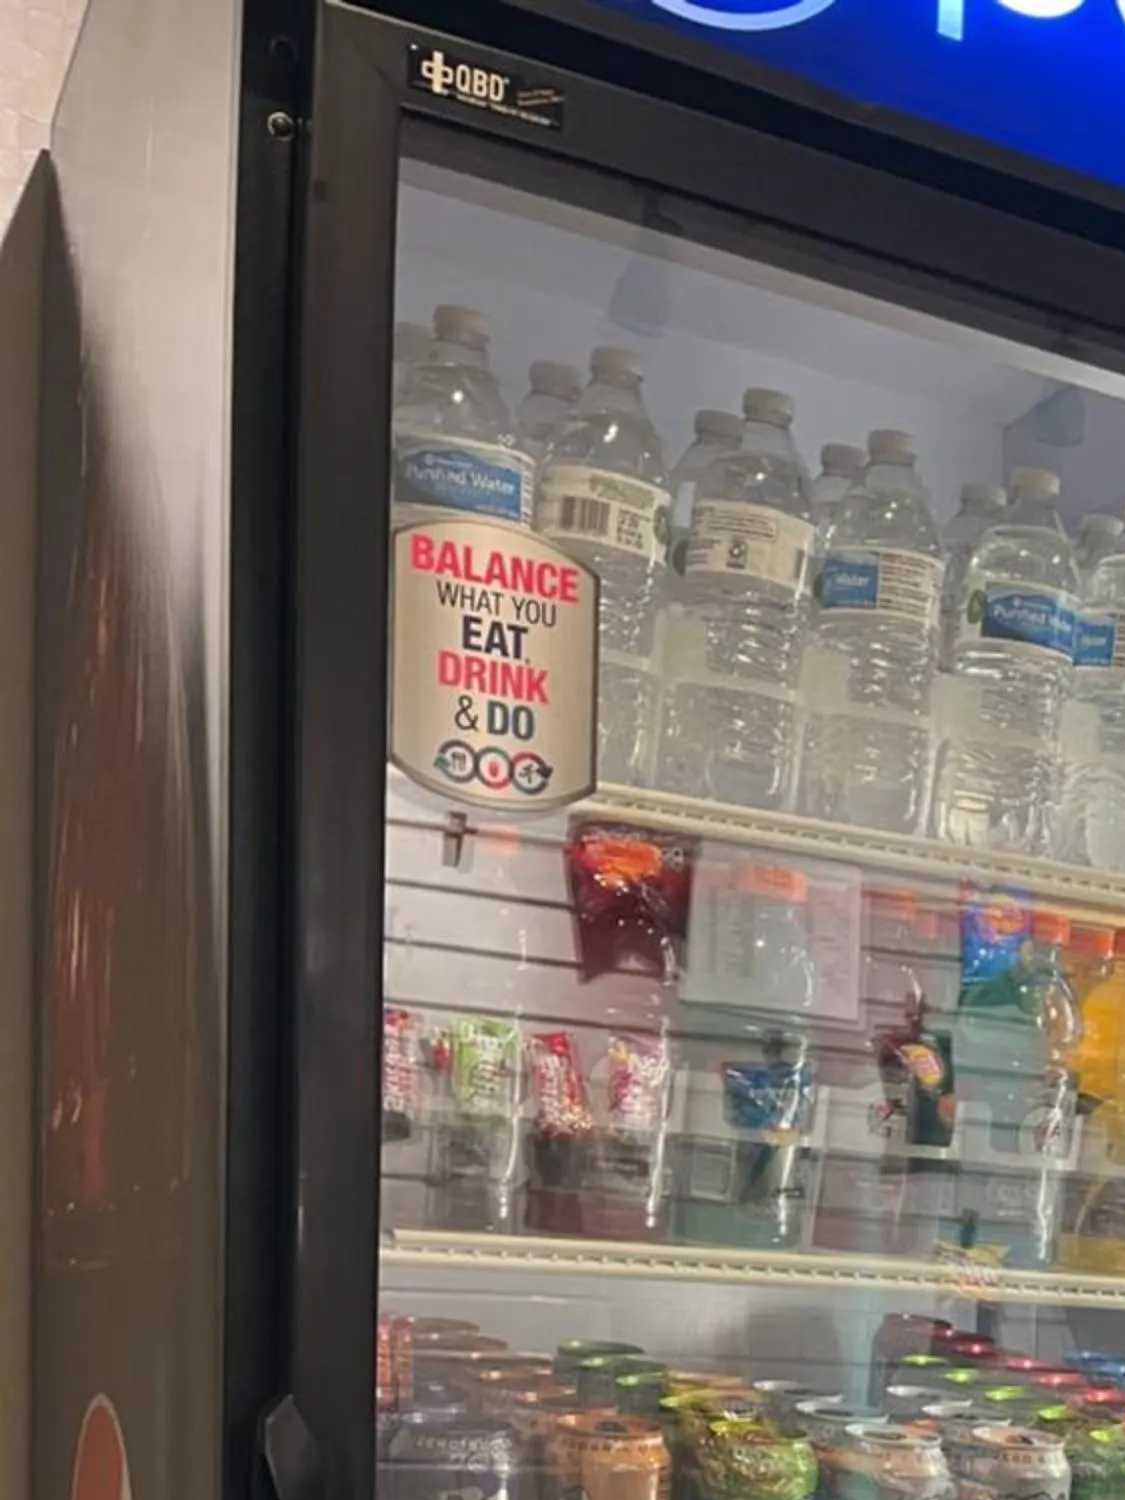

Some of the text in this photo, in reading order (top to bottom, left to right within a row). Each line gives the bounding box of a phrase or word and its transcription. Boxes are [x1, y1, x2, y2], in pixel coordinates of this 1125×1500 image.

[456, 64, 505, 103] QBD
[470, 470, 515, 496] Water
[411, 534, 580, 603] BALANCE
[436, 579, 557, 628] WHAT YOU
[437, 650, 549, 704] DRINK
[454, 695, 536, 742] & DO
